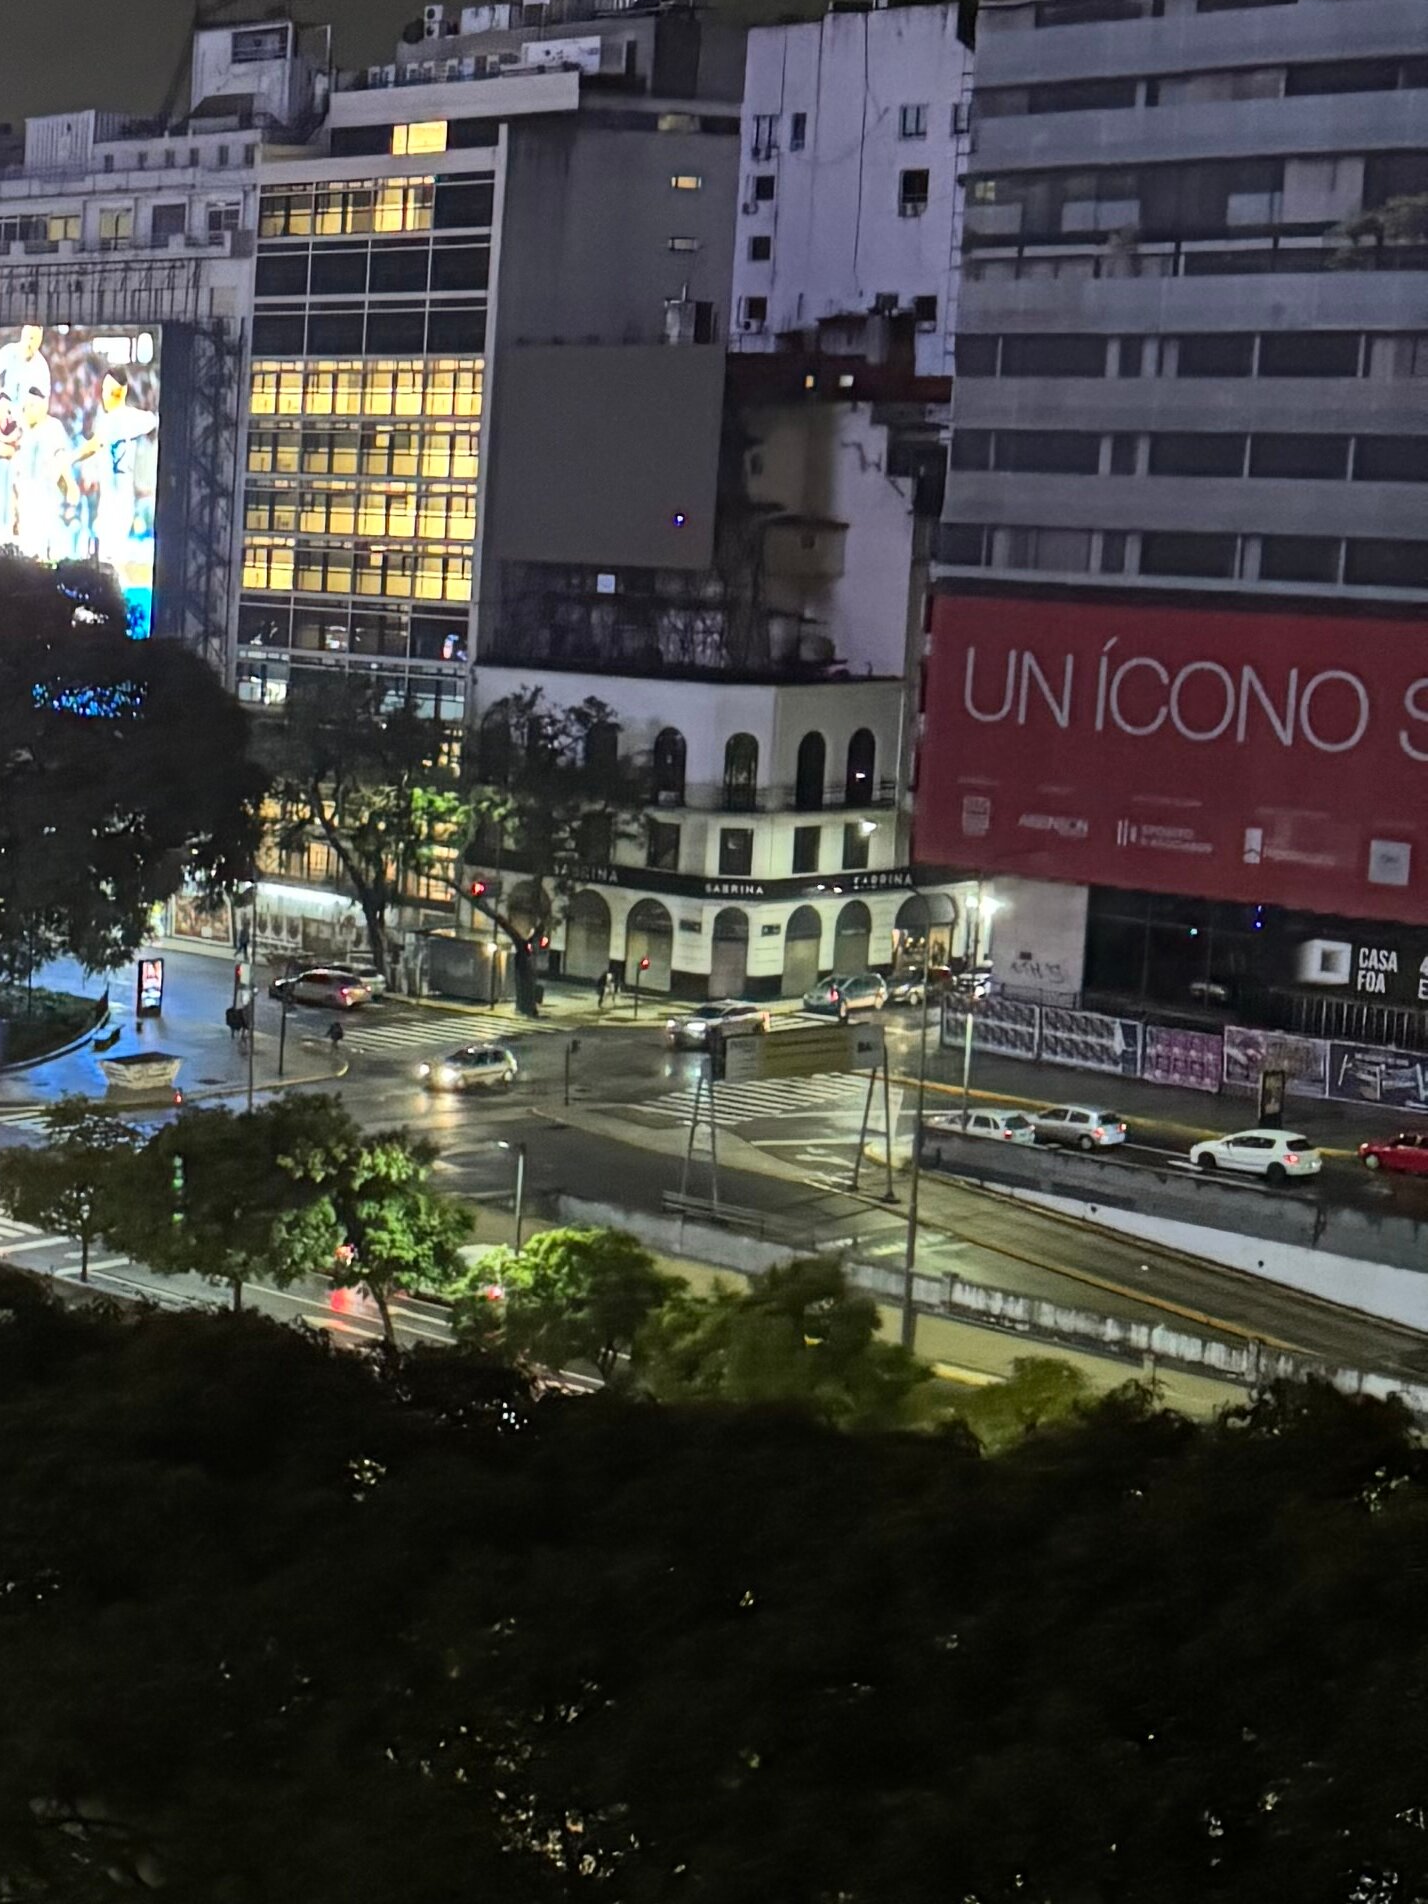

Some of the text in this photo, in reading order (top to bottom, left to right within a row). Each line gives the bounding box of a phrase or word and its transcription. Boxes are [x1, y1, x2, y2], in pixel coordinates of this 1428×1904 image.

[963, 646, 1074, 729] UN
[1095, 636, 1370, 753] ÍCONO
[705, 882, 764, 895] SABRINA
[1359, 947, 1398, 973] CASA
[1357, 969, 1386, 994] FOA
